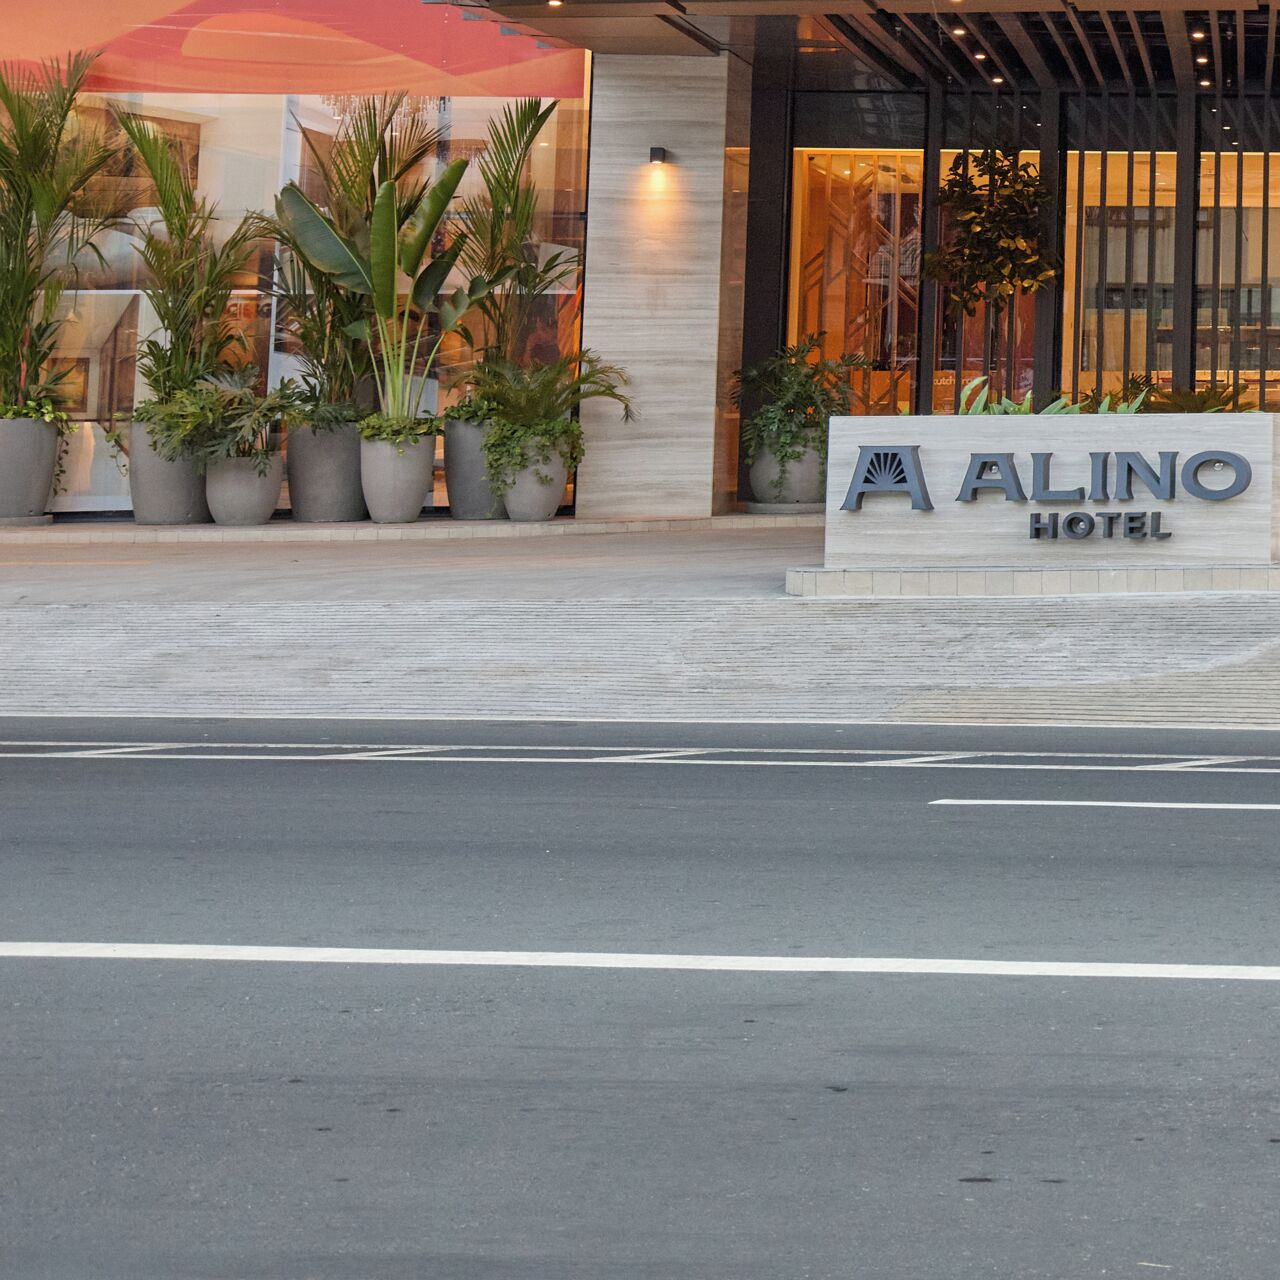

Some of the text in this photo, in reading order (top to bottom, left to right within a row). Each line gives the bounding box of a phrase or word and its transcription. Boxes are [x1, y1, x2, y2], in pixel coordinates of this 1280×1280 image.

[840, 445, 1252, 511] A ALINO
[1029, 511, 1172, 540] HOTEL
